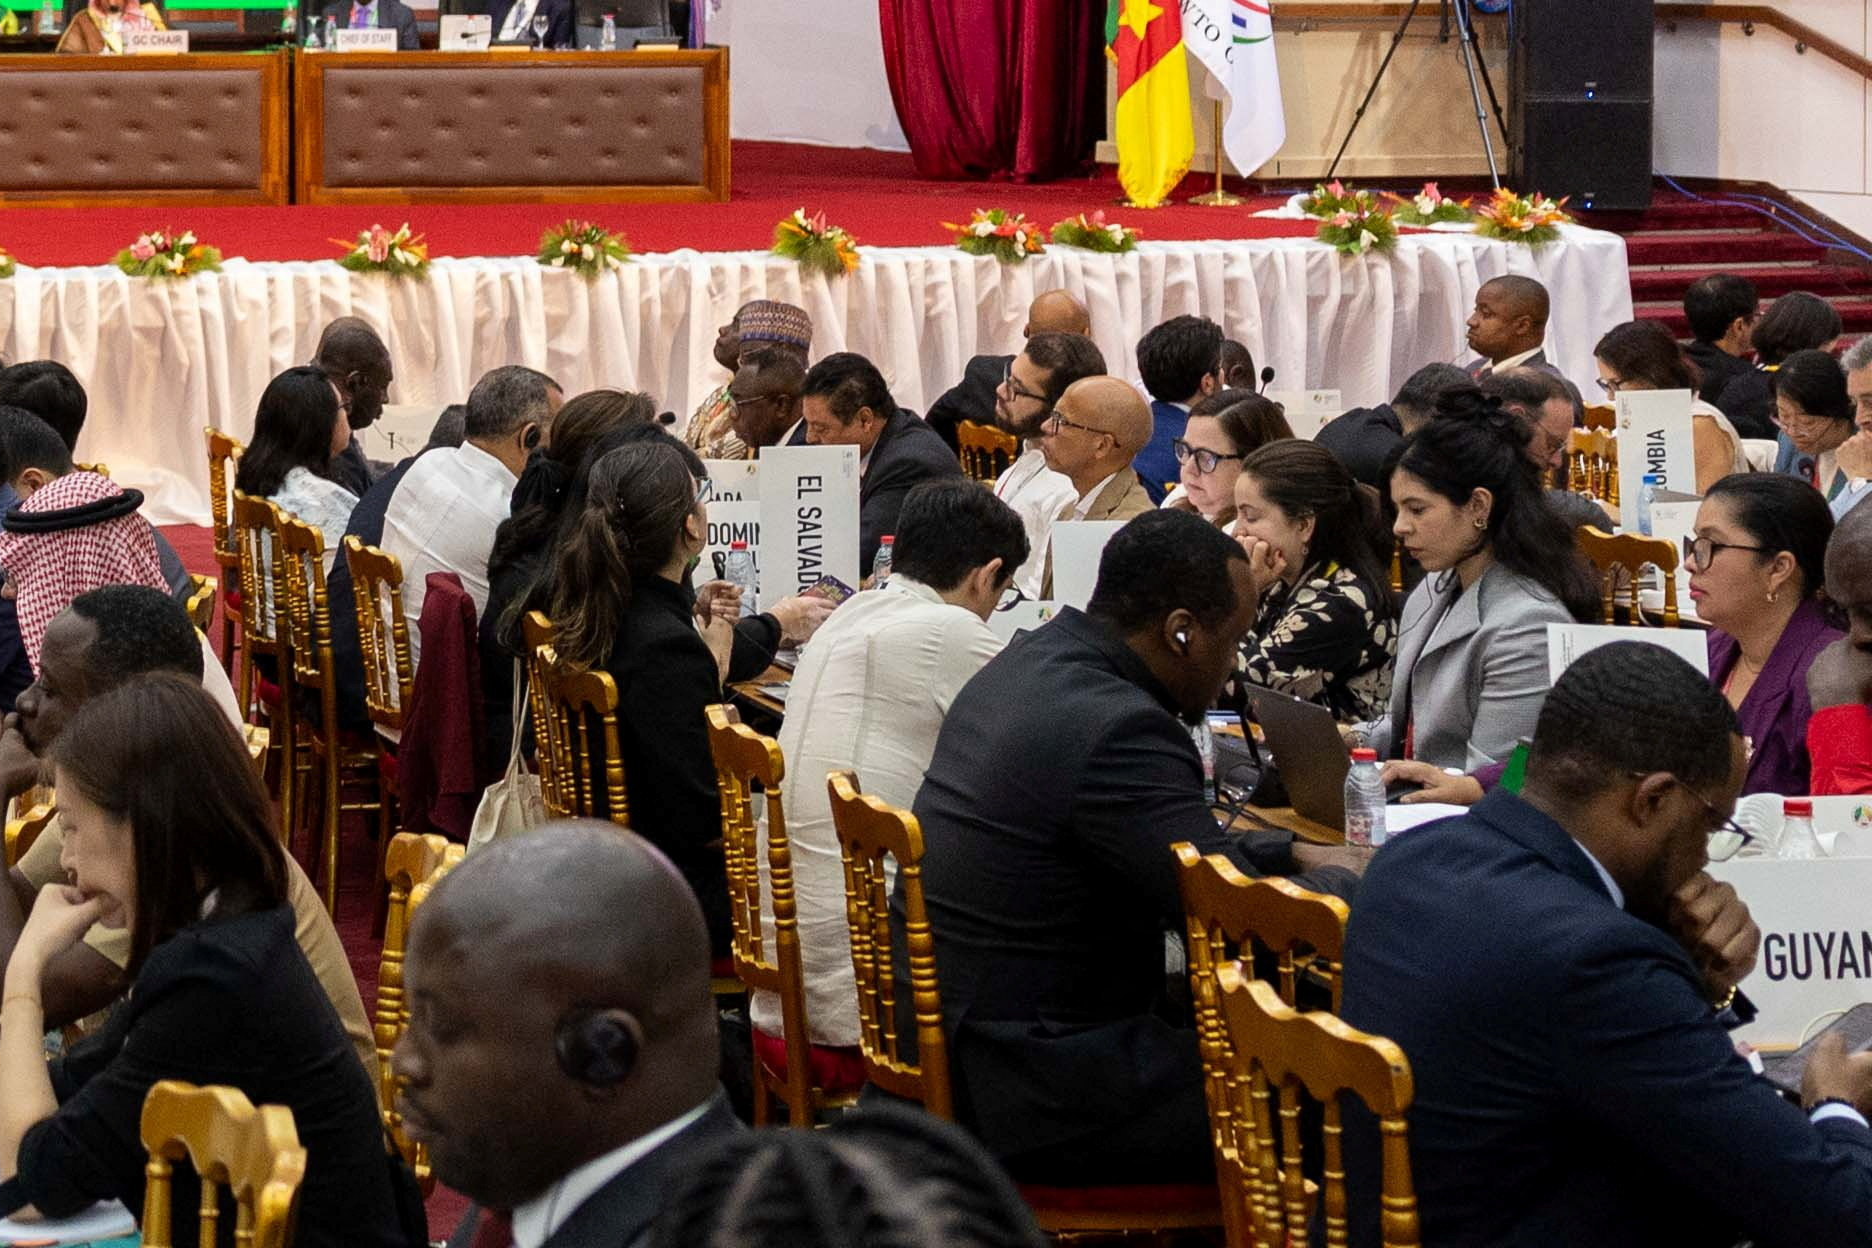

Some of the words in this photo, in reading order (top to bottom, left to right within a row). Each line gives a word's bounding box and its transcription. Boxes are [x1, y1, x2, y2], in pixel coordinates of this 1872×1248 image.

[151, 36, 183, 46] CHAIR
[1646, 429, 1668, 490] OMBIA
[797, 475, 822, 500] EL
[797, 506, 822, 596] SALVAD
